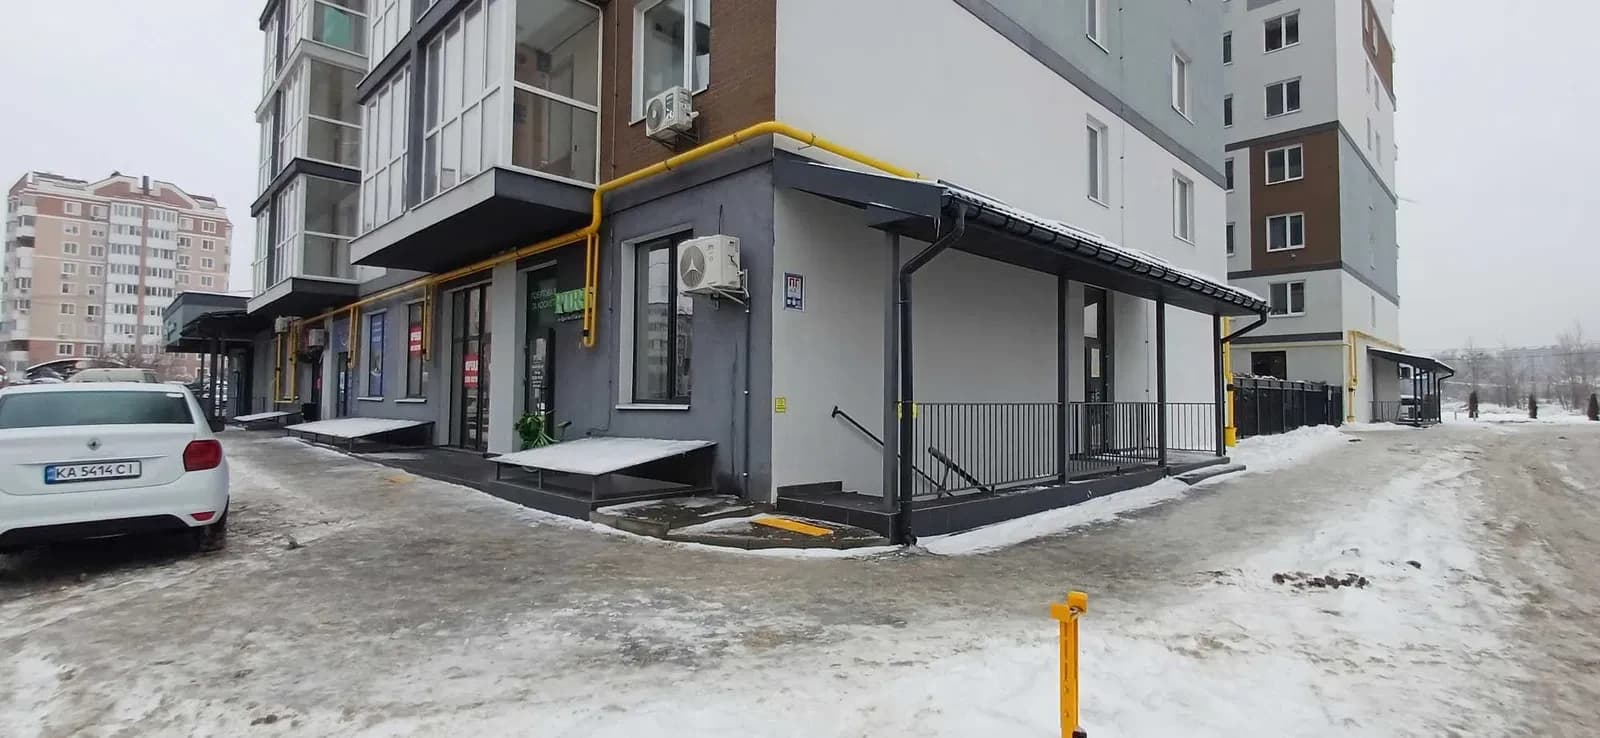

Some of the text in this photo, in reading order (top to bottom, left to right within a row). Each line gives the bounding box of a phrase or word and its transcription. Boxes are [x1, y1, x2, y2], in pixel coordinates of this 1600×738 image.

[56, 463, 132, 479] KA 5414 CI
